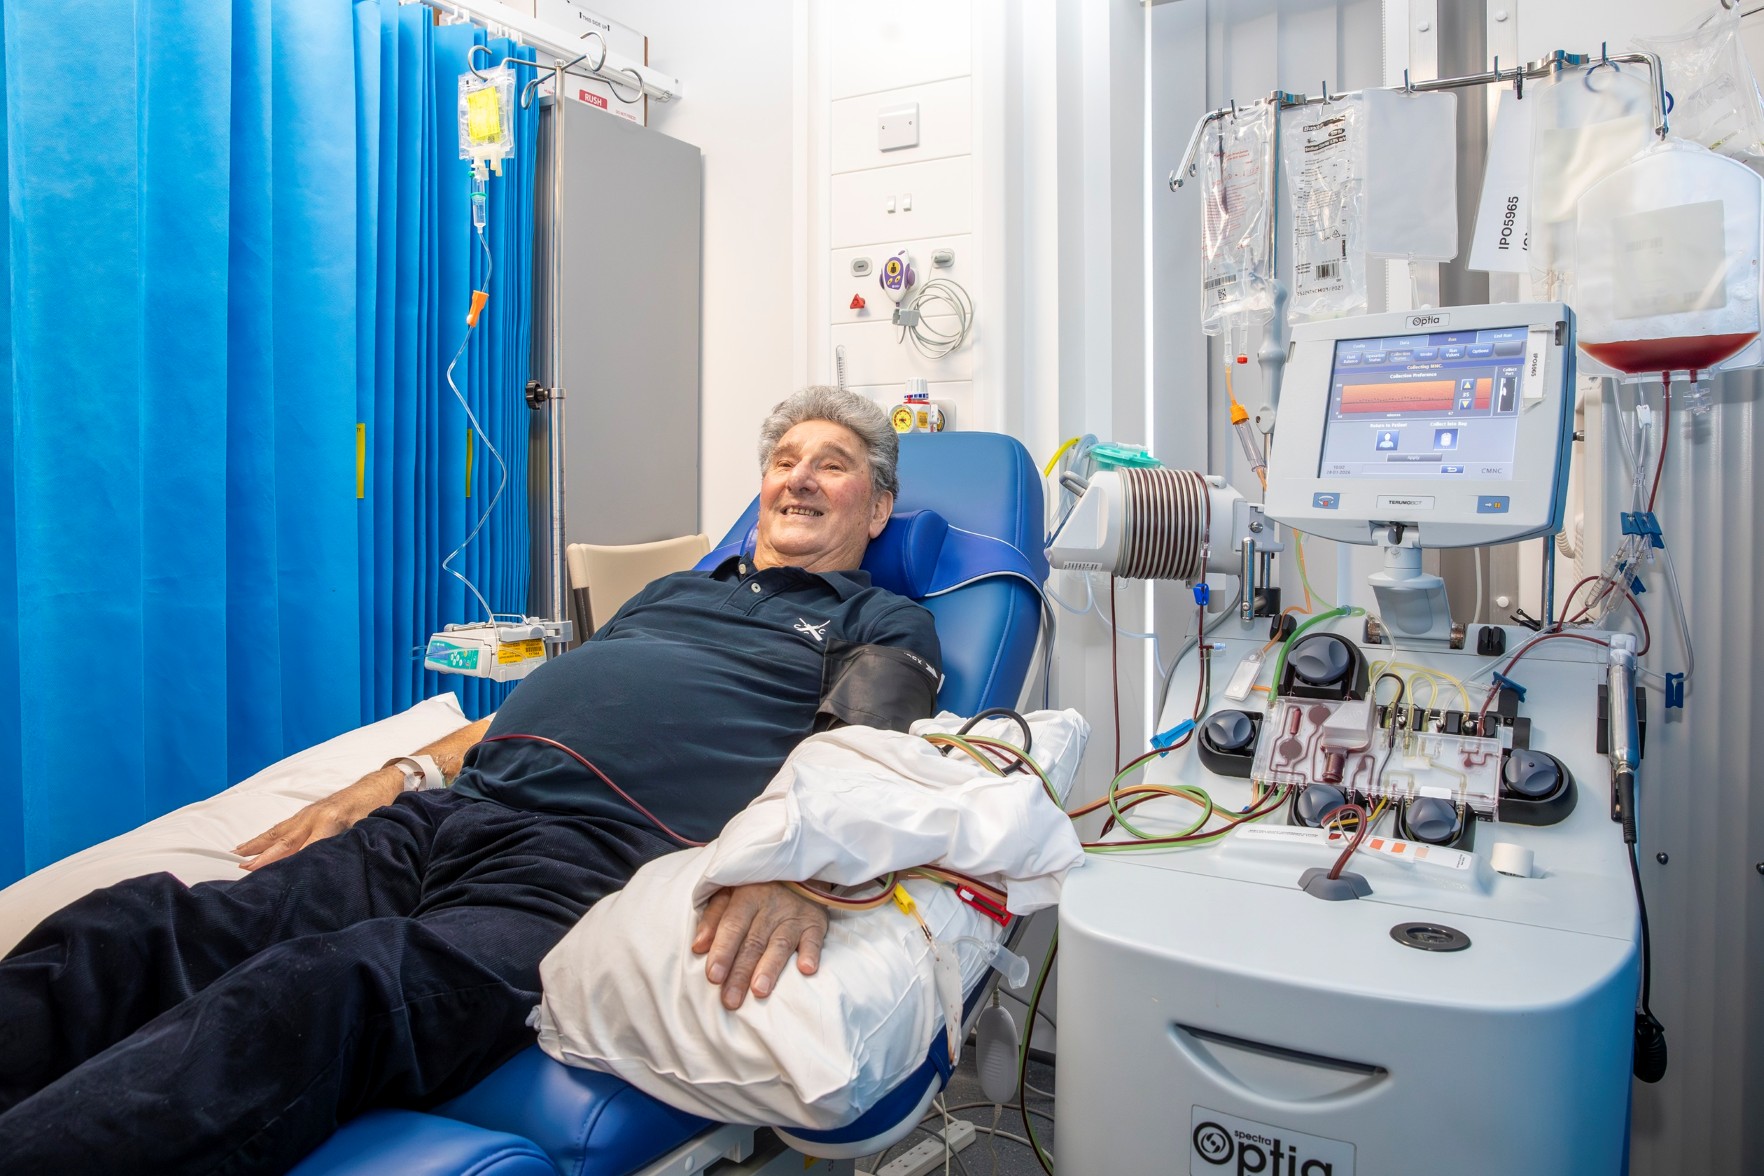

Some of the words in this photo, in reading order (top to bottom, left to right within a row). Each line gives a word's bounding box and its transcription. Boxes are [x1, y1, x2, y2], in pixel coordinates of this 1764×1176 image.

[585, 93, 602, 106] RUSH
[1498, 196, 1519, 250] IPO5965
[1412, 316, 1440, 326] Optia
[1234, 1130, 1272, 1147] spectra
[1192, 1121, 1333, 1176] Optia
